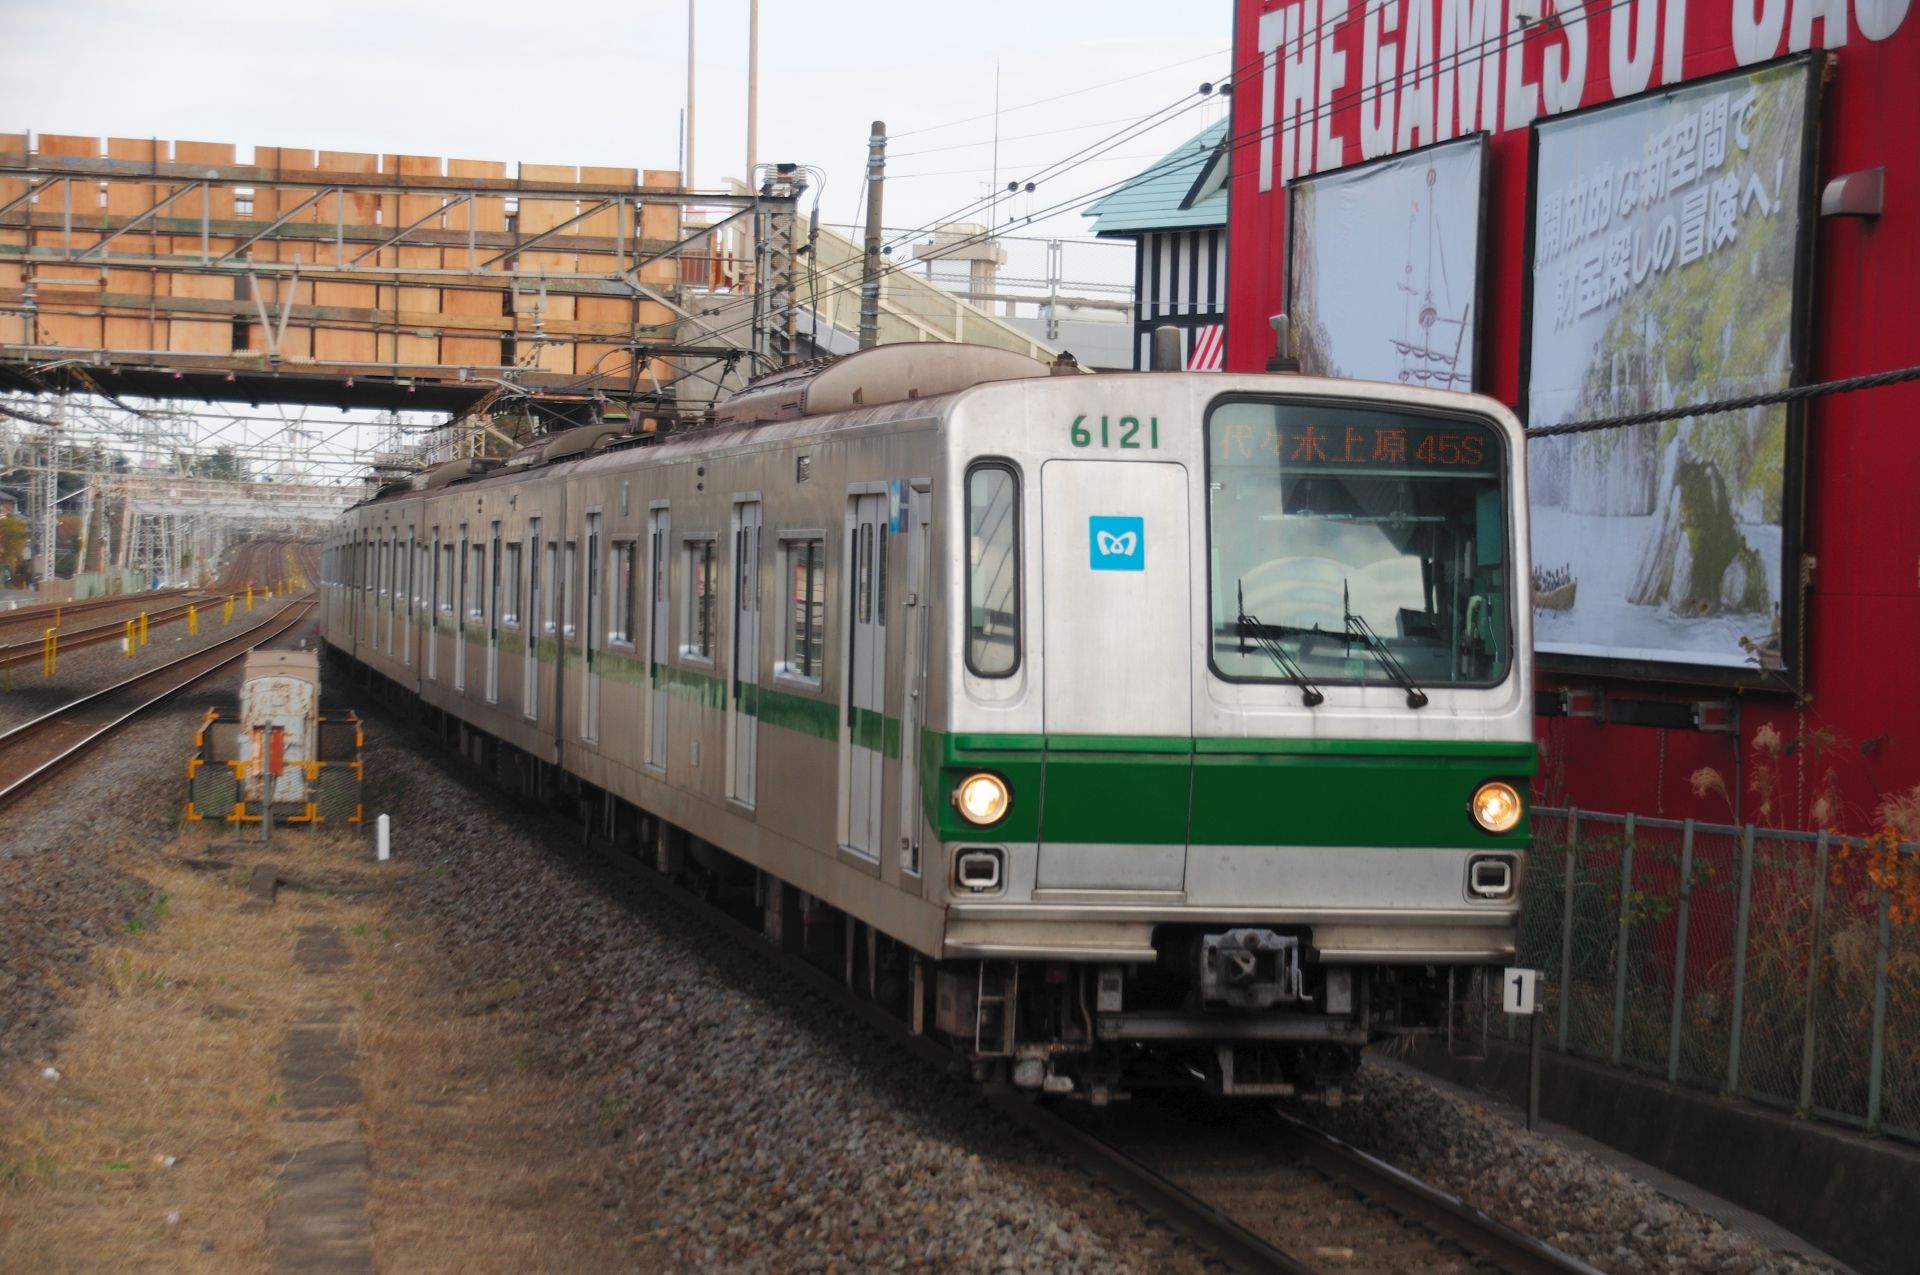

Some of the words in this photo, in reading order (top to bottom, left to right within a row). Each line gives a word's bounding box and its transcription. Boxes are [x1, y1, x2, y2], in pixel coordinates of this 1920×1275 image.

[1258, 0, 1348, 193] THE
[1360, 0, 1588, 161] GAMES
[1539, 88, 1757, 262] 開放的な新空間で
[1070, 415, 1159, 449] 6121
[1219, 423, 1408, 464] 代々木上原
[1415, 435, 1486, 466] 45S
[1511, 974, 1523, 1007] 1
